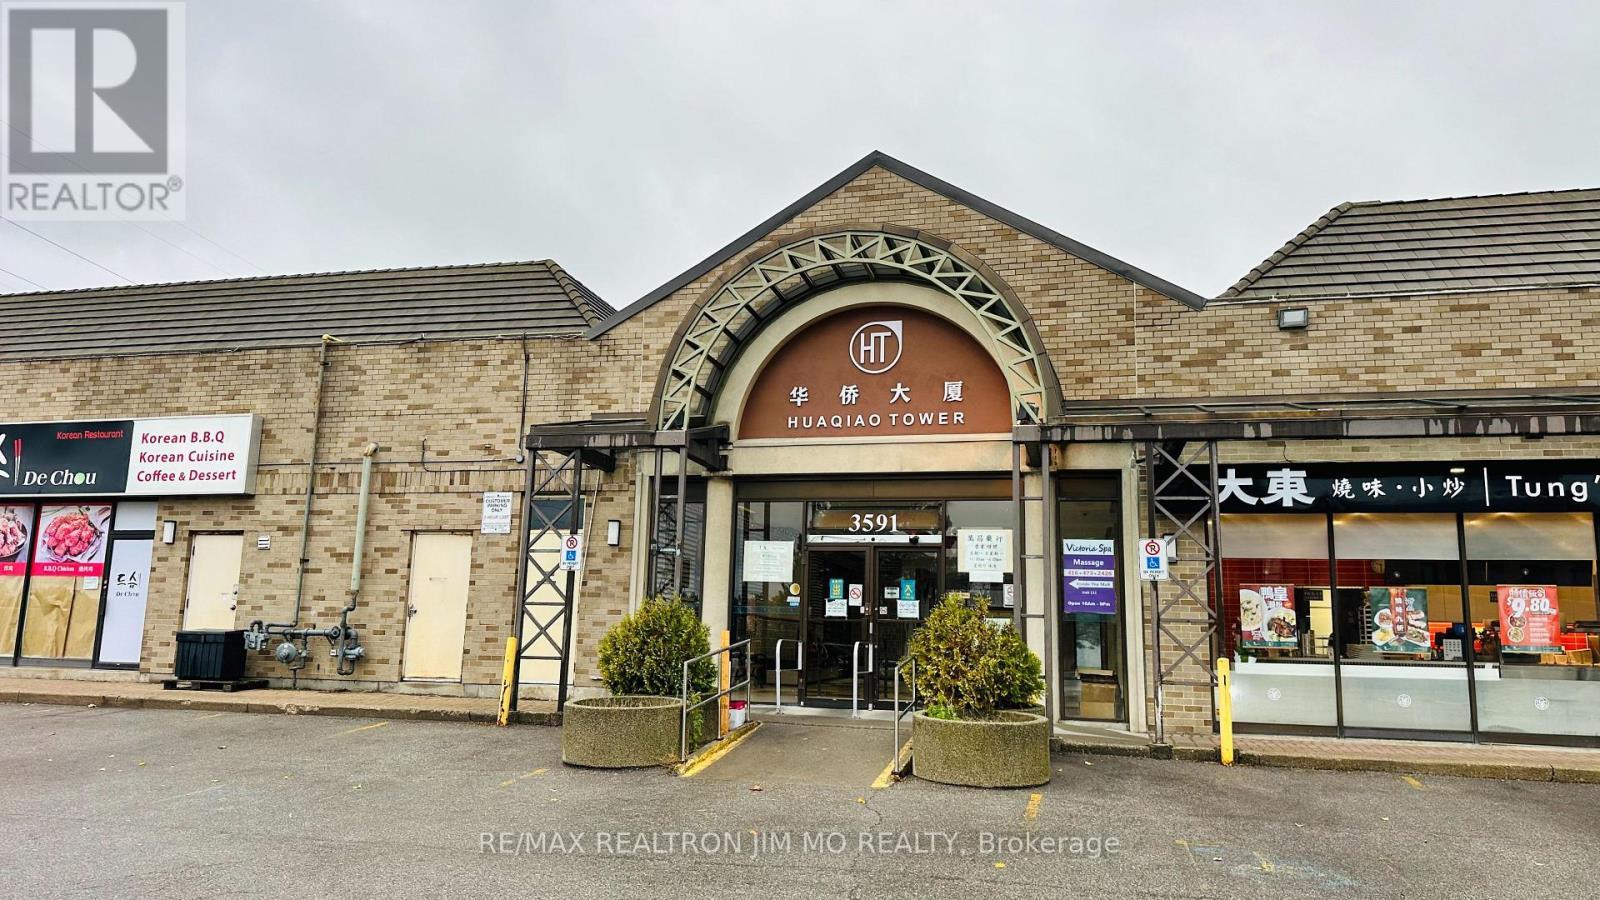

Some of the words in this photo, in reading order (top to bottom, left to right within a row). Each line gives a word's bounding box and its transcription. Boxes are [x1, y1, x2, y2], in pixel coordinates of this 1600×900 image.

[860, 331, 892, 364] HT
[789, 381, 964, 407] 华侨大厦
[787, 413, 881, 429] HUAQIAO
[888, 412, 965, 427] TOWER
[57, 431, 82, 440] Korean
[84, 429, 124, 439] Restaurant
[141, 432, 186, 444] Korean
[190, 430, 225, 444] B.B.Q
[139, 451, 184, 463] Korean
[188, 449, 235, 462] Cuisine
[22, 470, 48, 486] De
[50, 468, 97, 486] Chou
[137, 469, 176, 482] Coffee
[178, 471, 186, 481] &
[188, 469, 237, 481] Dessert
[1218, 468, 1316, 507] 大東
[848, 513, 900, 533] 3591
[1065, 543, 1098, 553] Victoria
[1098, 543, 1112, 554] Spa
[1073, 558, 1105, 567] Massage
